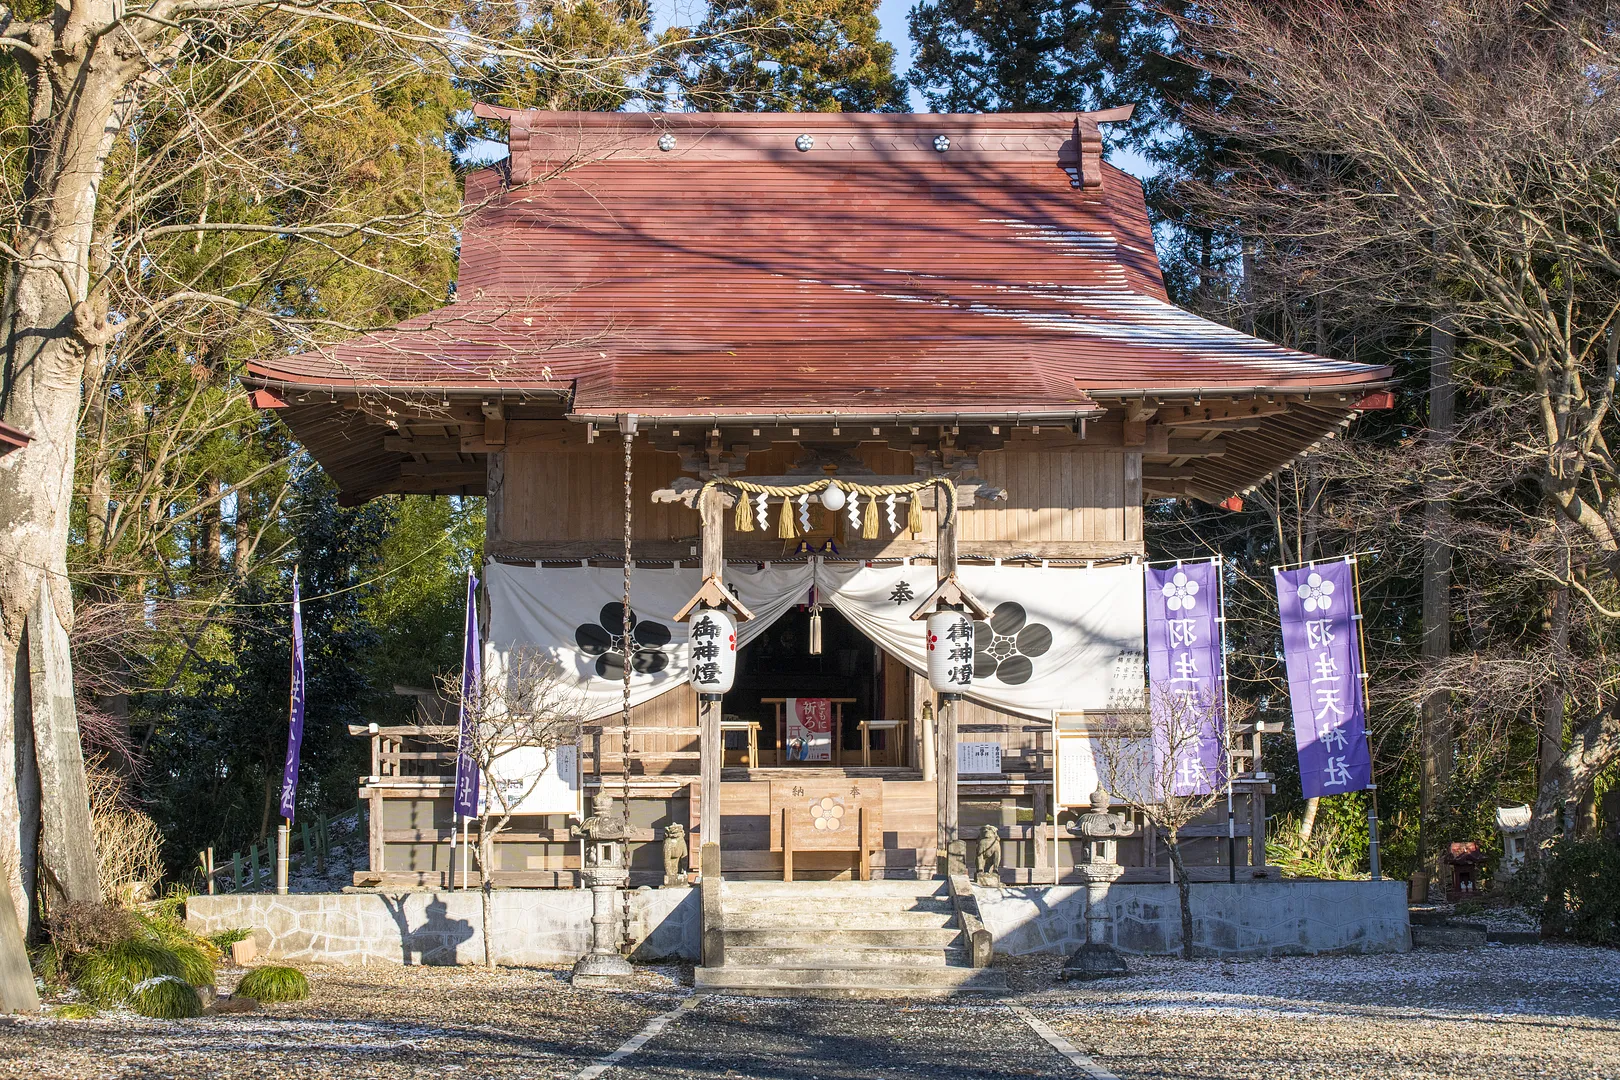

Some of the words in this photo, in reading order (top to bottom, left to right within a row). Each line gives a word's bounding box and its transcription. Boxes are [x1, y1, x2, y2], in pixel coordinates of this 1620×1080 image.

[888, 581, 914, 606] 奉
[691, 615, 722, 685] 御神燈
[946, 616, 973, 685] 御神燈
[802, 701, 817, 742] 祈ろう
[818, 700, 827, 729] ともに
[792, 785, 804, 797] 納
[849, 785, 861, 799] 奉
